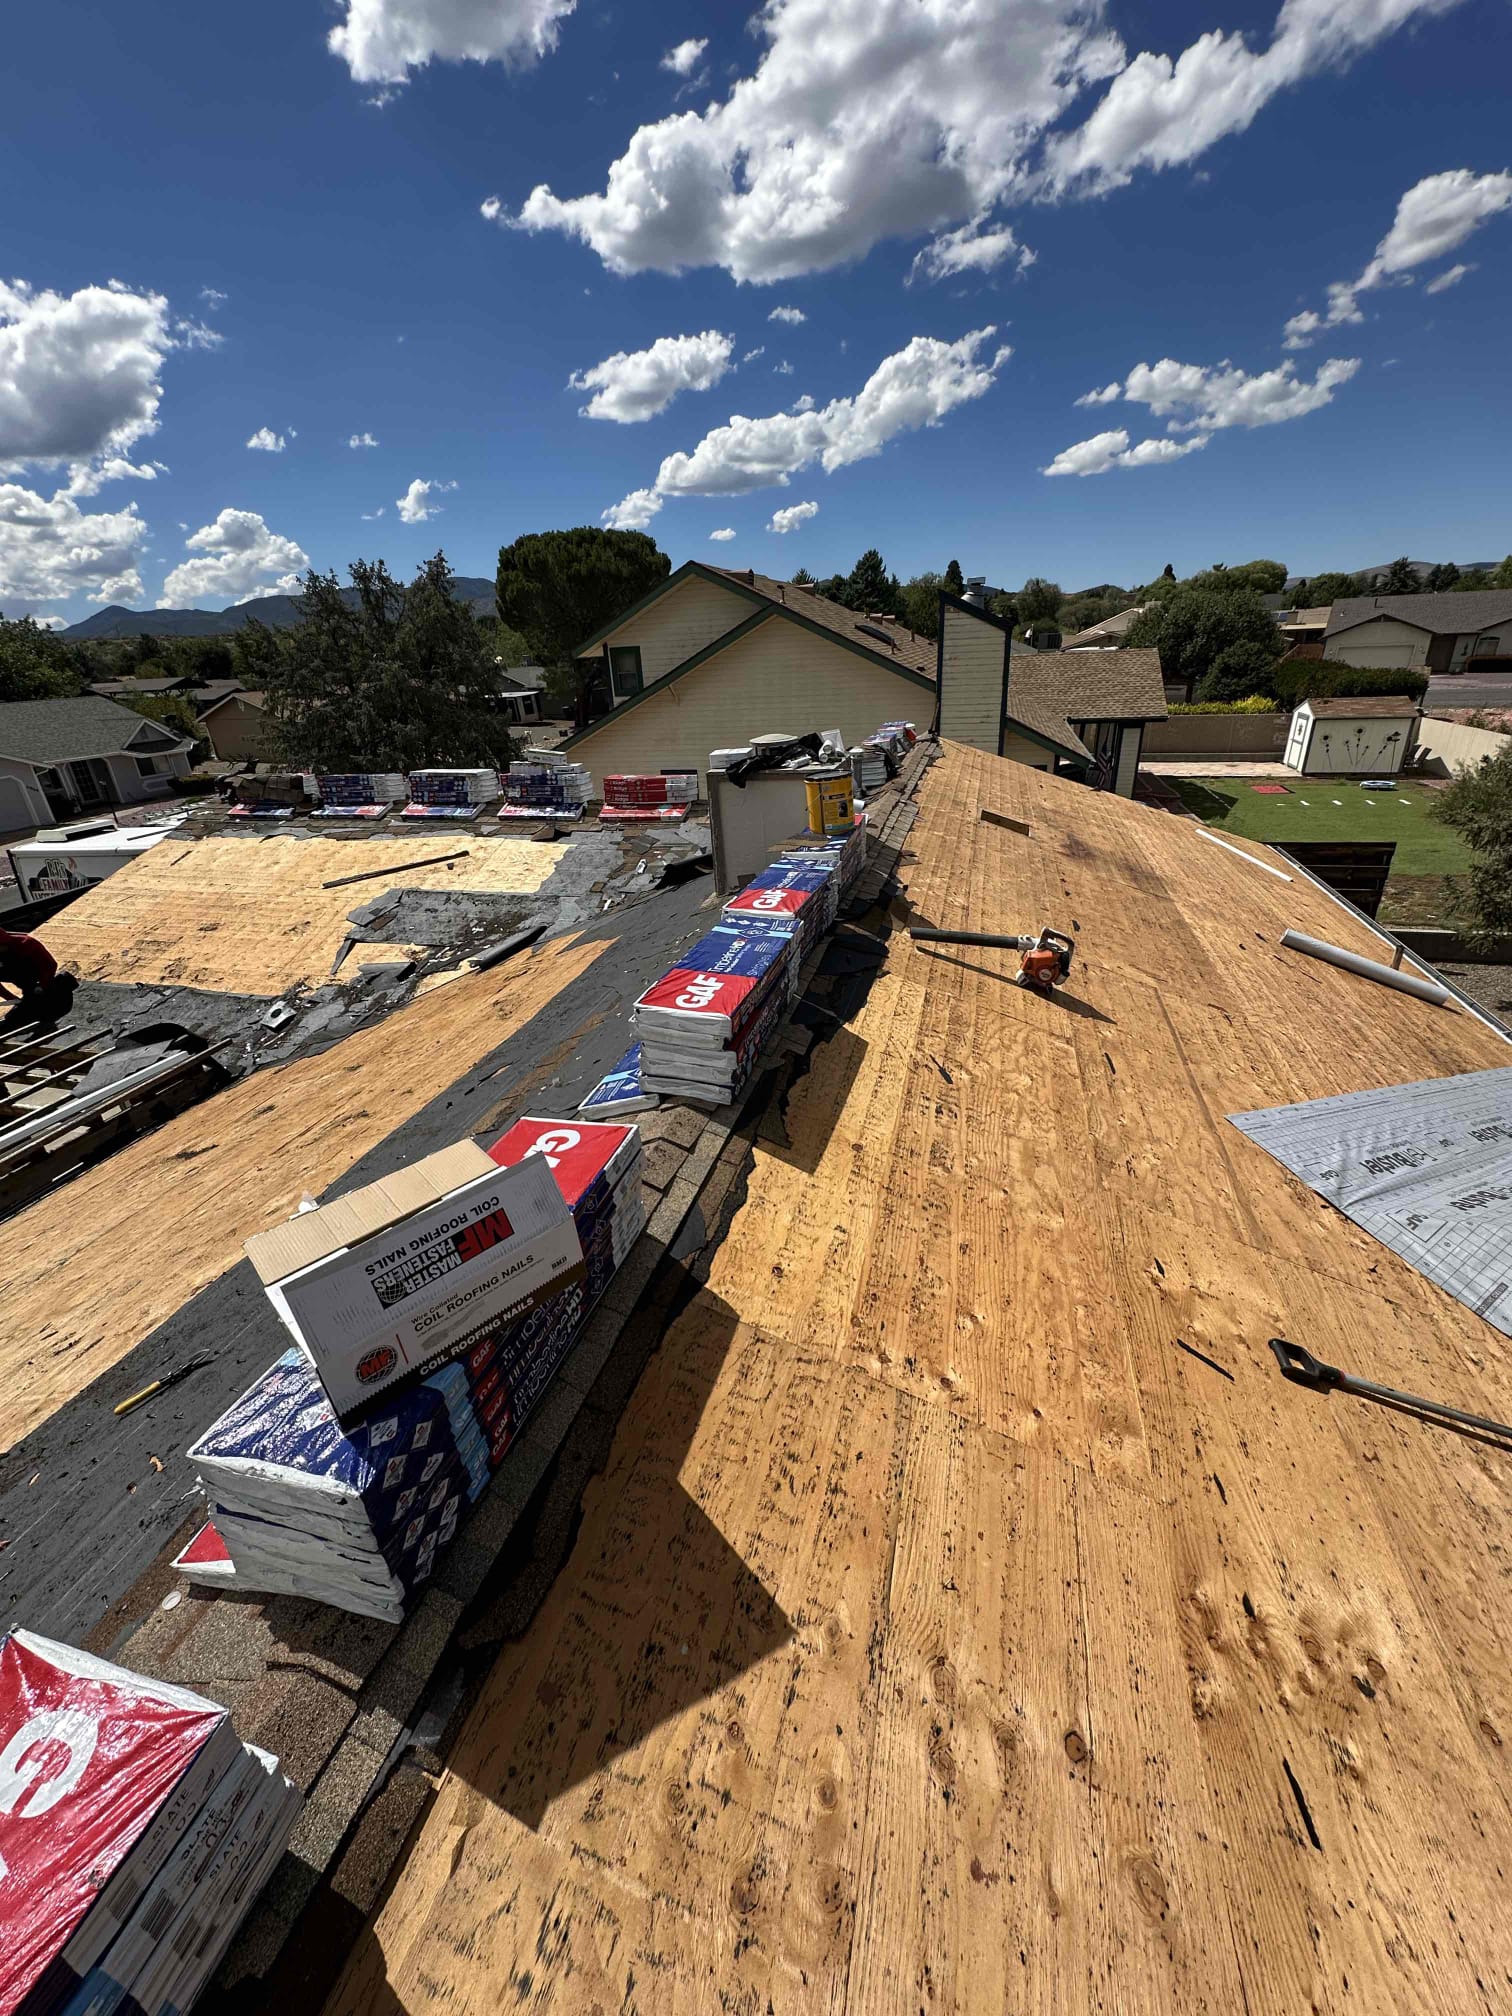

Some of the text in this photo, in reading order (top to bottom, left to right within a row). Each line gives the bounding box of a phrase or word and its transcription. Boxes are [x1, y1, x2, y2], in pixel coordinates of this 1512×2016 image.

[752, 888, 788, 909] GAF
[675, 974, 725, 1008] GAF
[365, 1196, 500, 1276] COIL ROOFING NAILS
[456, 1208, 514, 1263] MF
[373, 1238, 456, 1292] FASTENERS
[403, 1251, 462, 1293] MASTER
[411, 1293, 459, 1324] Wire Collated
[414, 1255, 534, 1332] COIL ROOFING NAILS
[420, 1297, 535, 1376] COIL ROOFING NAILS
[472, 1339, 493, 1368] GAF
[359, 1346, 399, 1379] MF
